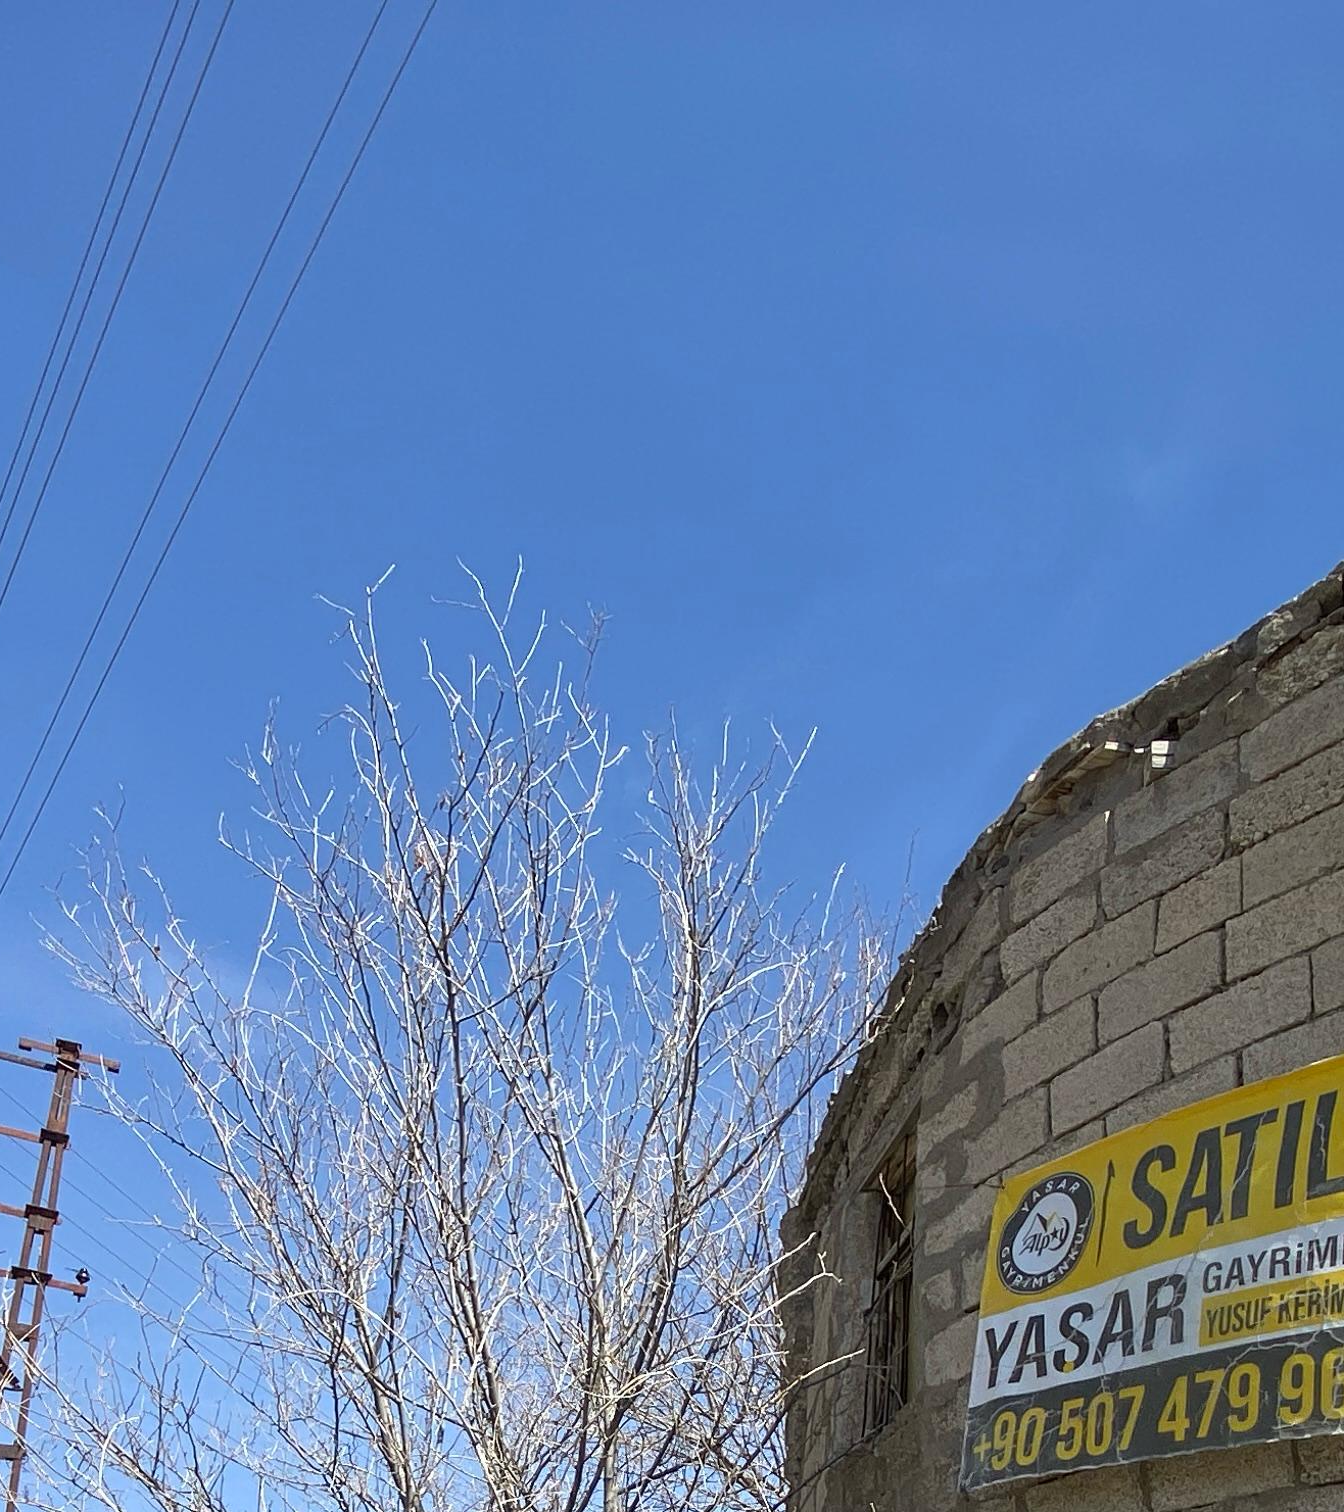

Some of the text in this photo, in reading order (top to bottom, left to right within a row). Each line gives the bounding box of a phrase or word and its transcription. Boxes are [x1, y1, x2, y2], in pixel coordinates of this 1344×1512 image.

[984, 1273, 1188, 1390] YASAR
[1206, 1300, 1272, 1338] YUSUF
[973, 1406, 1048, 1471] +90
[1056, 1384, 1146, 1461] 507
[1158, 1362, 1262, 1442] 479
